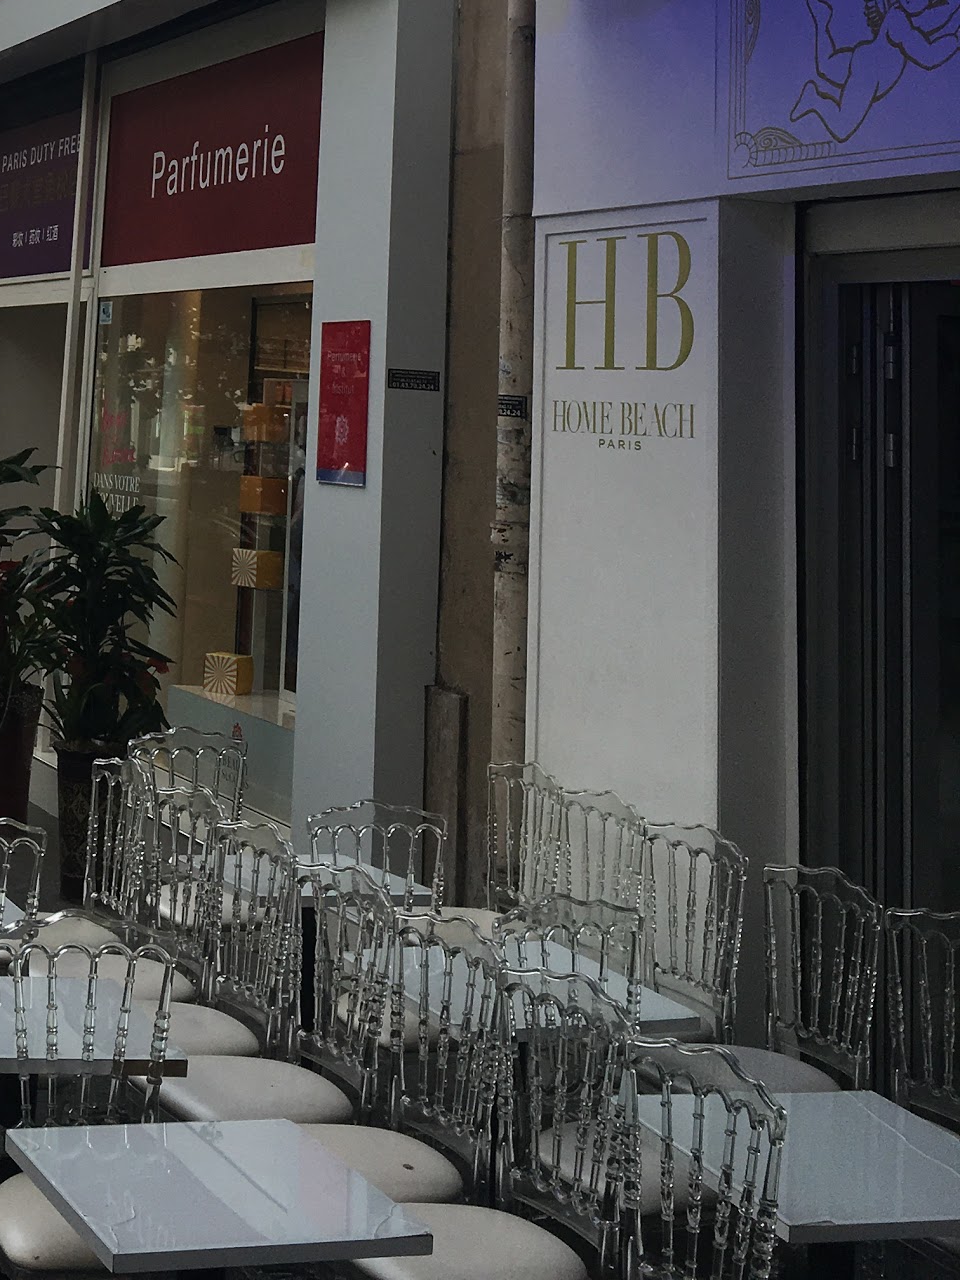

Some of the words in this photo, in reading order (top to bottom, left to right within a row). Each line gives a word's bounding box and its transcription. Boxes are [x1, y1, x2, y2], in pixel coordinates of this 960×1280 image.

[1, 149, 28, 173] PARIS
[30, 140, 56, 164] DUTY
[57, 133, 81, 157] FREE
[151, 124, 286, 199] Parfumerie
[556, 231, 695, 371] HB
[552, 400, 613, 435] HOME
[619, 401, 695, 439] BEACH
[598, 438, 642, 451] PARIS
[93, 472, 114, 489] DANS
[114, 474, 140, 493] VOTRE
